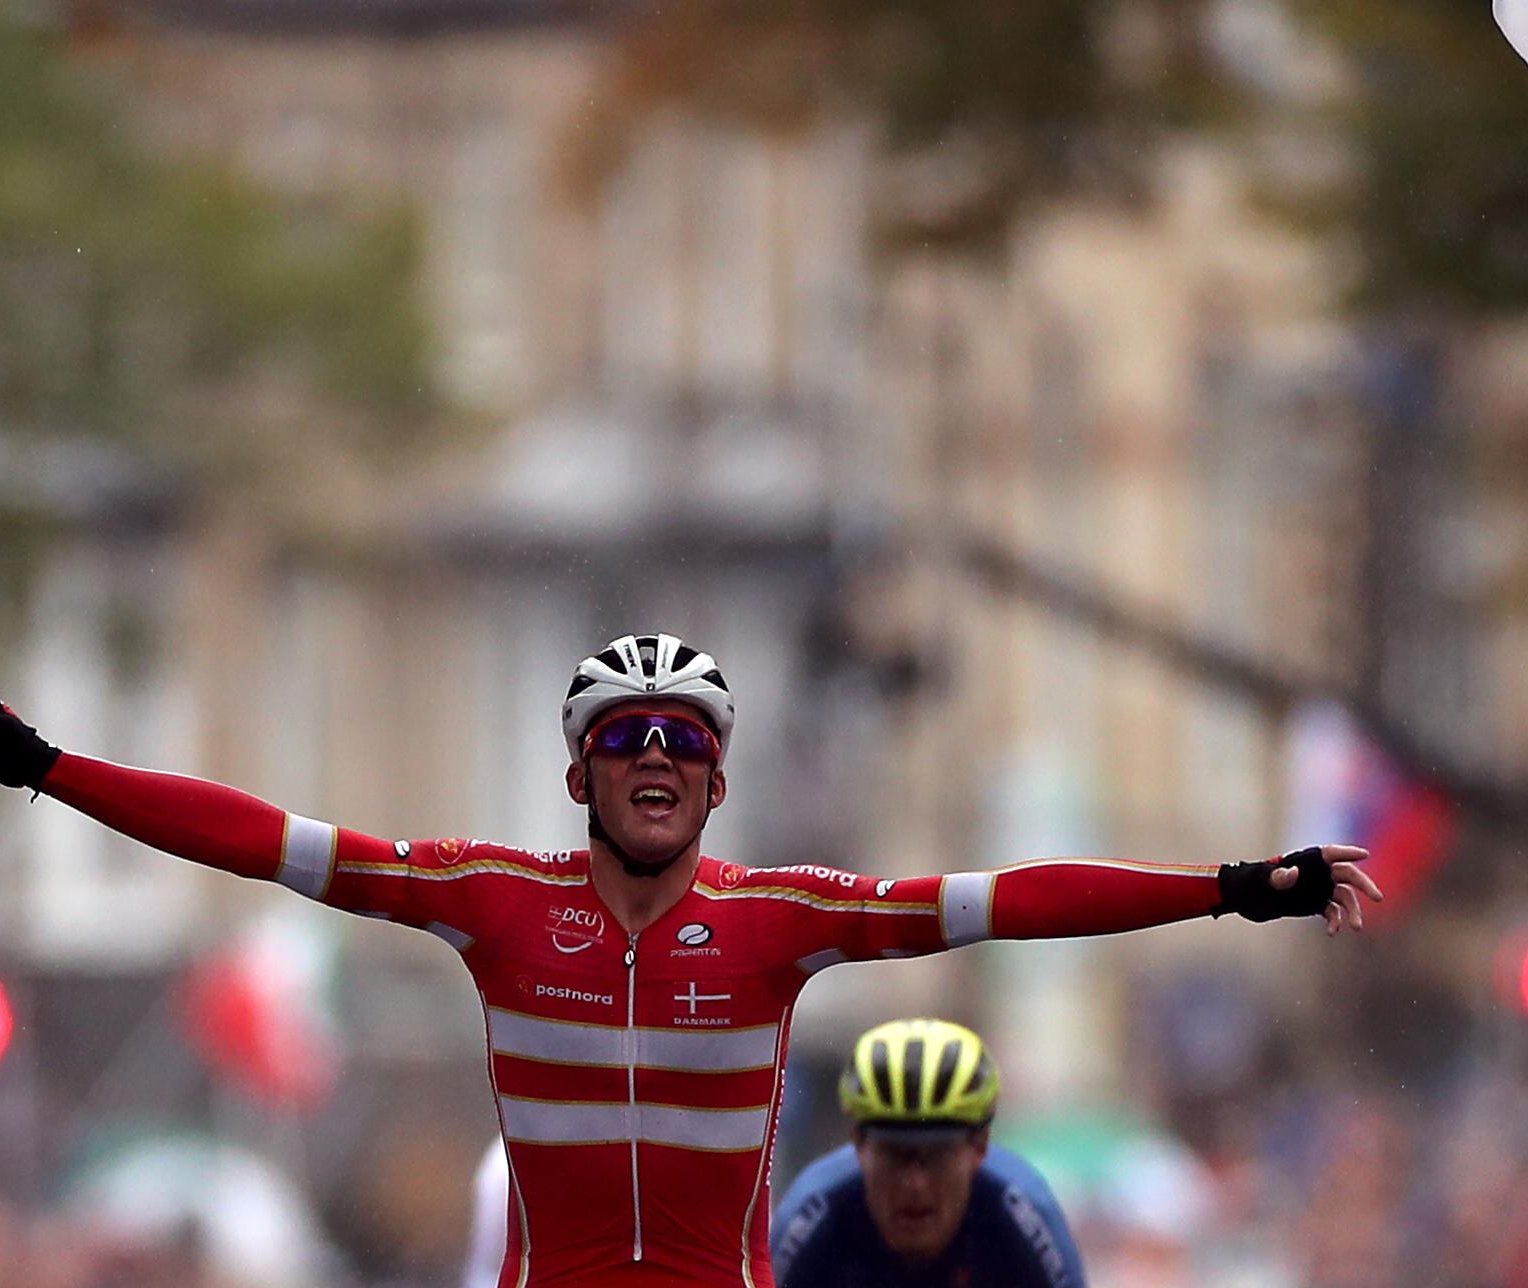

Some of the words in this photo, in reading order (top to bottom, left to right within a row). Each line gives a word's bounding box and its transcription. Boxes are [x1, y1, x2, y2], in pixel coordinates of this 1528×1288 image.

[562, 907, 598, 927] DCU
[536, 984, 614, 1005] postnord
[674, 1017, 731, 1025] DANMARK
